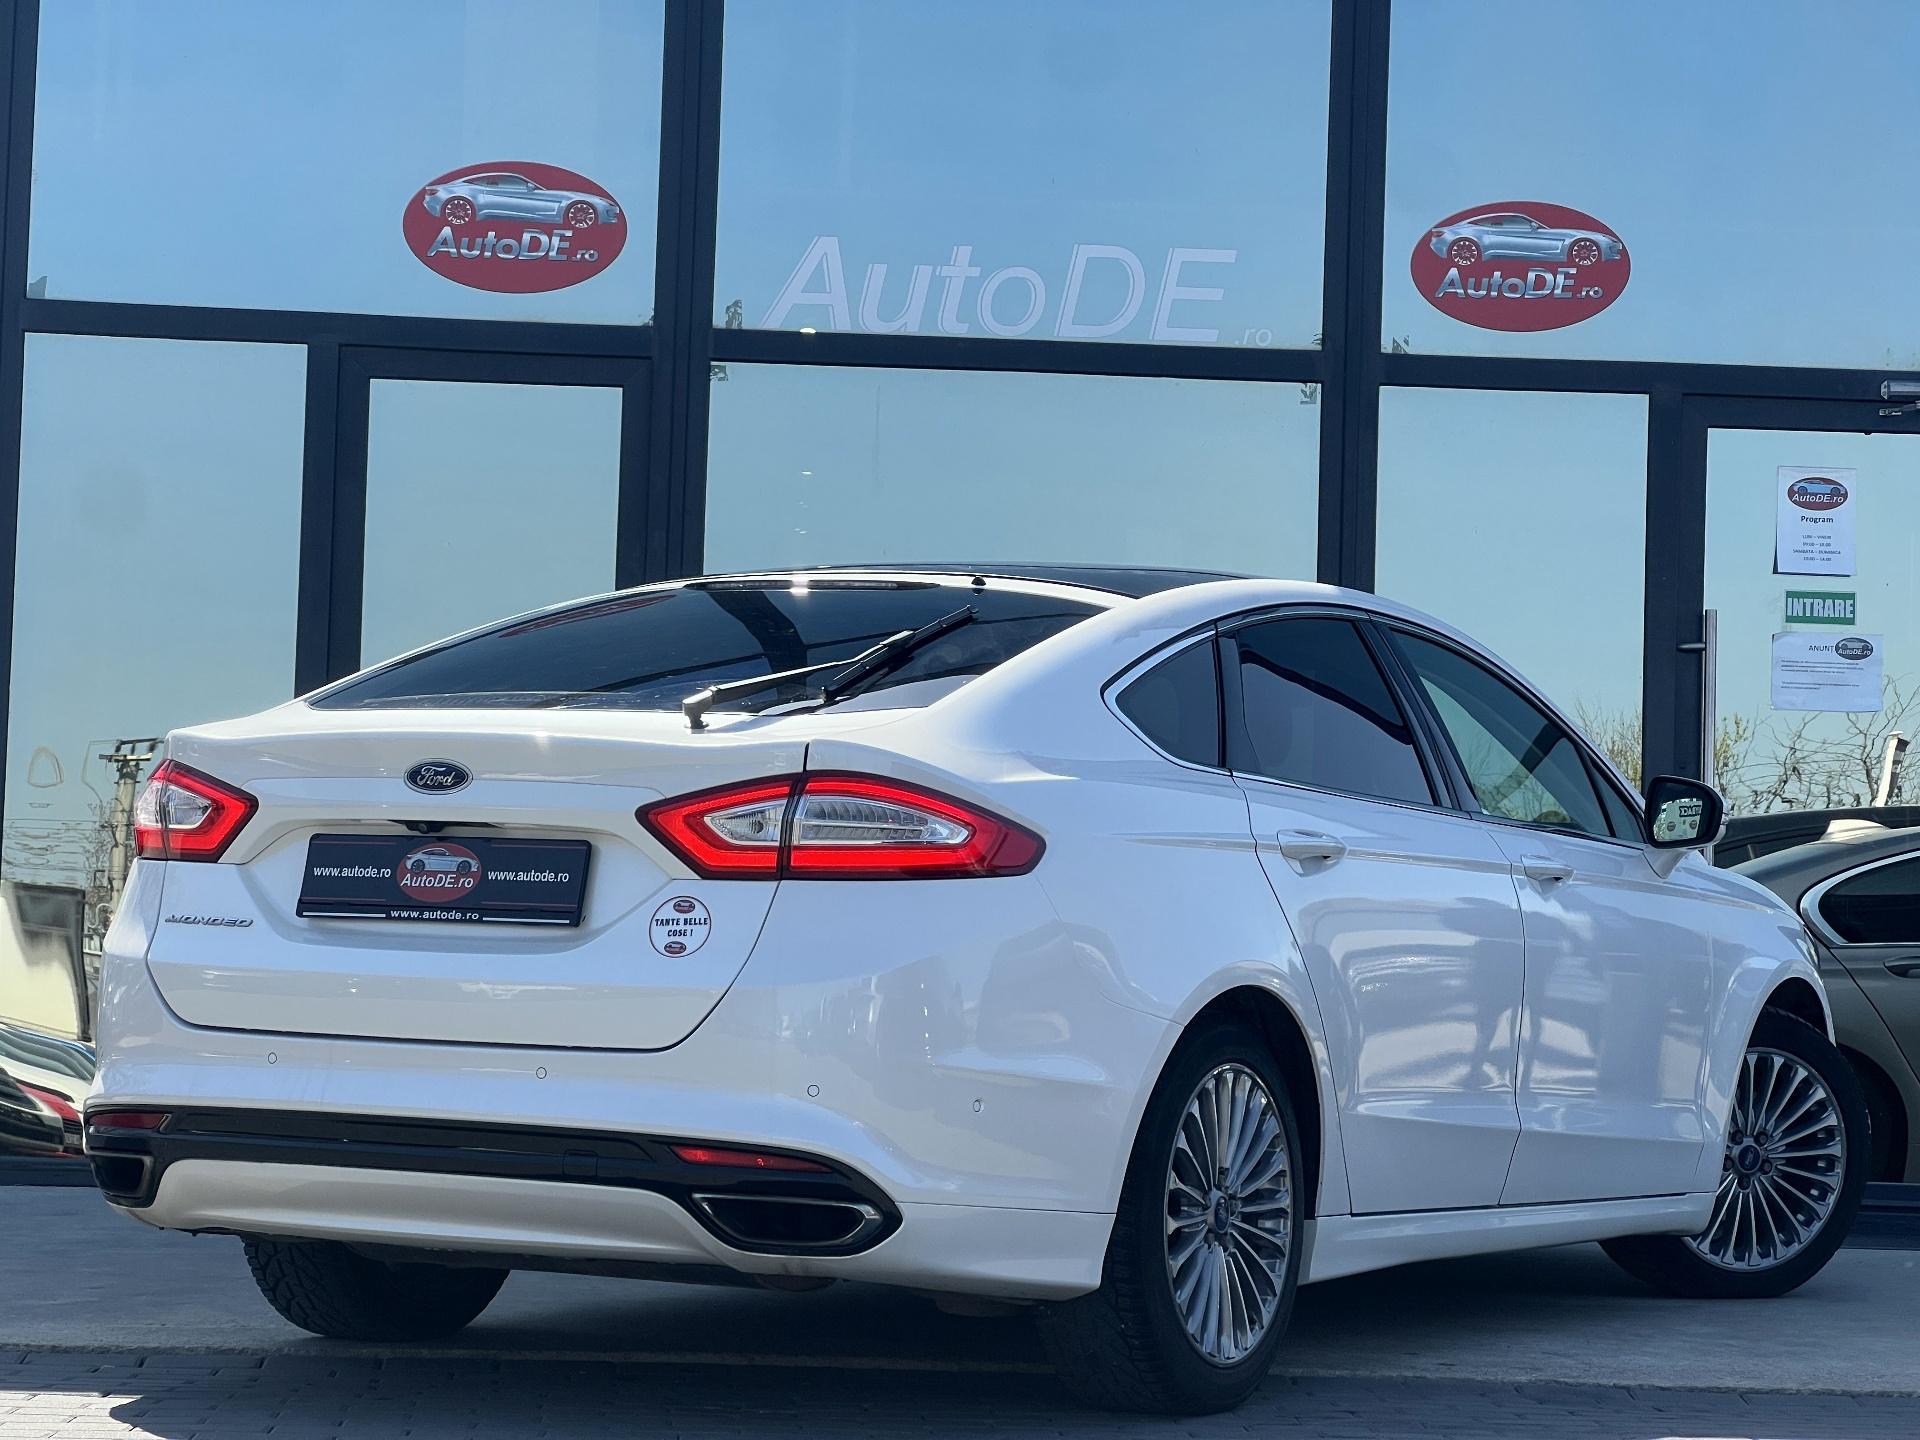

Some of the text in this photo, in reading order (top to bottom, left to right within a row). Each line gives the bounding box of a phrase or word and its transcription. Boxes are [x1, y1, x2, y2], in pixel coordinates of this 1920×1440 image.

[1791, 493, 1844, 503] AutoDE.ro
[1800, 515, 1834, 524] Program
[1787, 598, 1854, 618] INTRARE
[1837, 647, 1871, 656] AutoDE.ro
[417, 766, 458, 786] Ford
[313, 865, 391, 878] www.autode.ro
[488, 869, 569, 882] www.autode.ro
[400, 873, 474, 888] AutoDE.ro
[165, 914, 254, 927] MONDEO
[390, 910, 479, 920] www.autode.ro
[655, 917, 709, 926] TANTE BELLE
[667, 929, 688, 937] COSE
